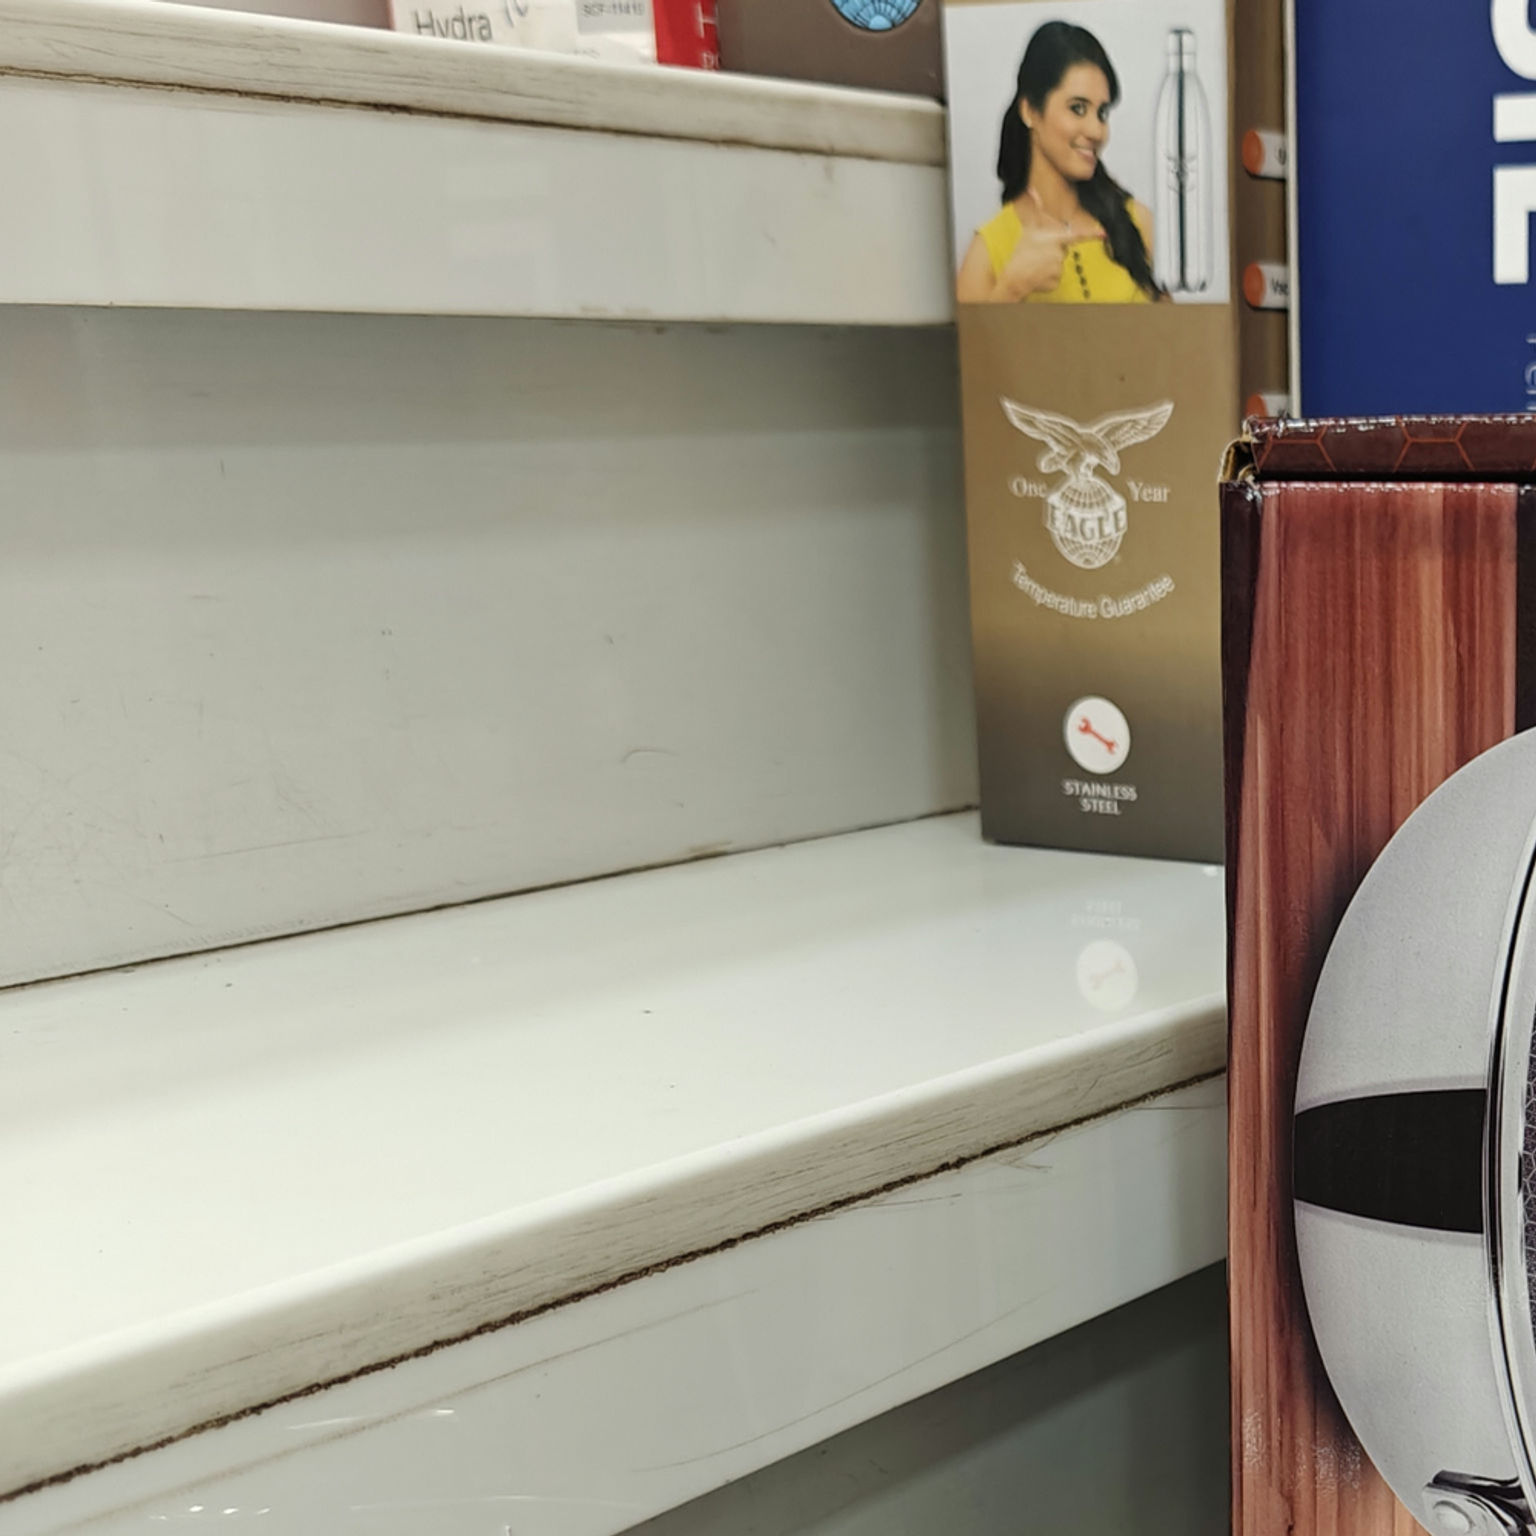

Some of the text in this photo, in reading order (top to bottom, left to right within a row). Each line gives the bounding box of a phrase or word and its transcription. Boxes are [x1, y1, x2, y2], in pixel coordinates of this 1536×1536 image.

[1126, 480, 1171, 503] Year
[1013, 560, 1175, 619] Temperature Guarantee
[1062, 780, 1138, 802] STAINLESS
[1080, 799, 1122, 816] STEEL
